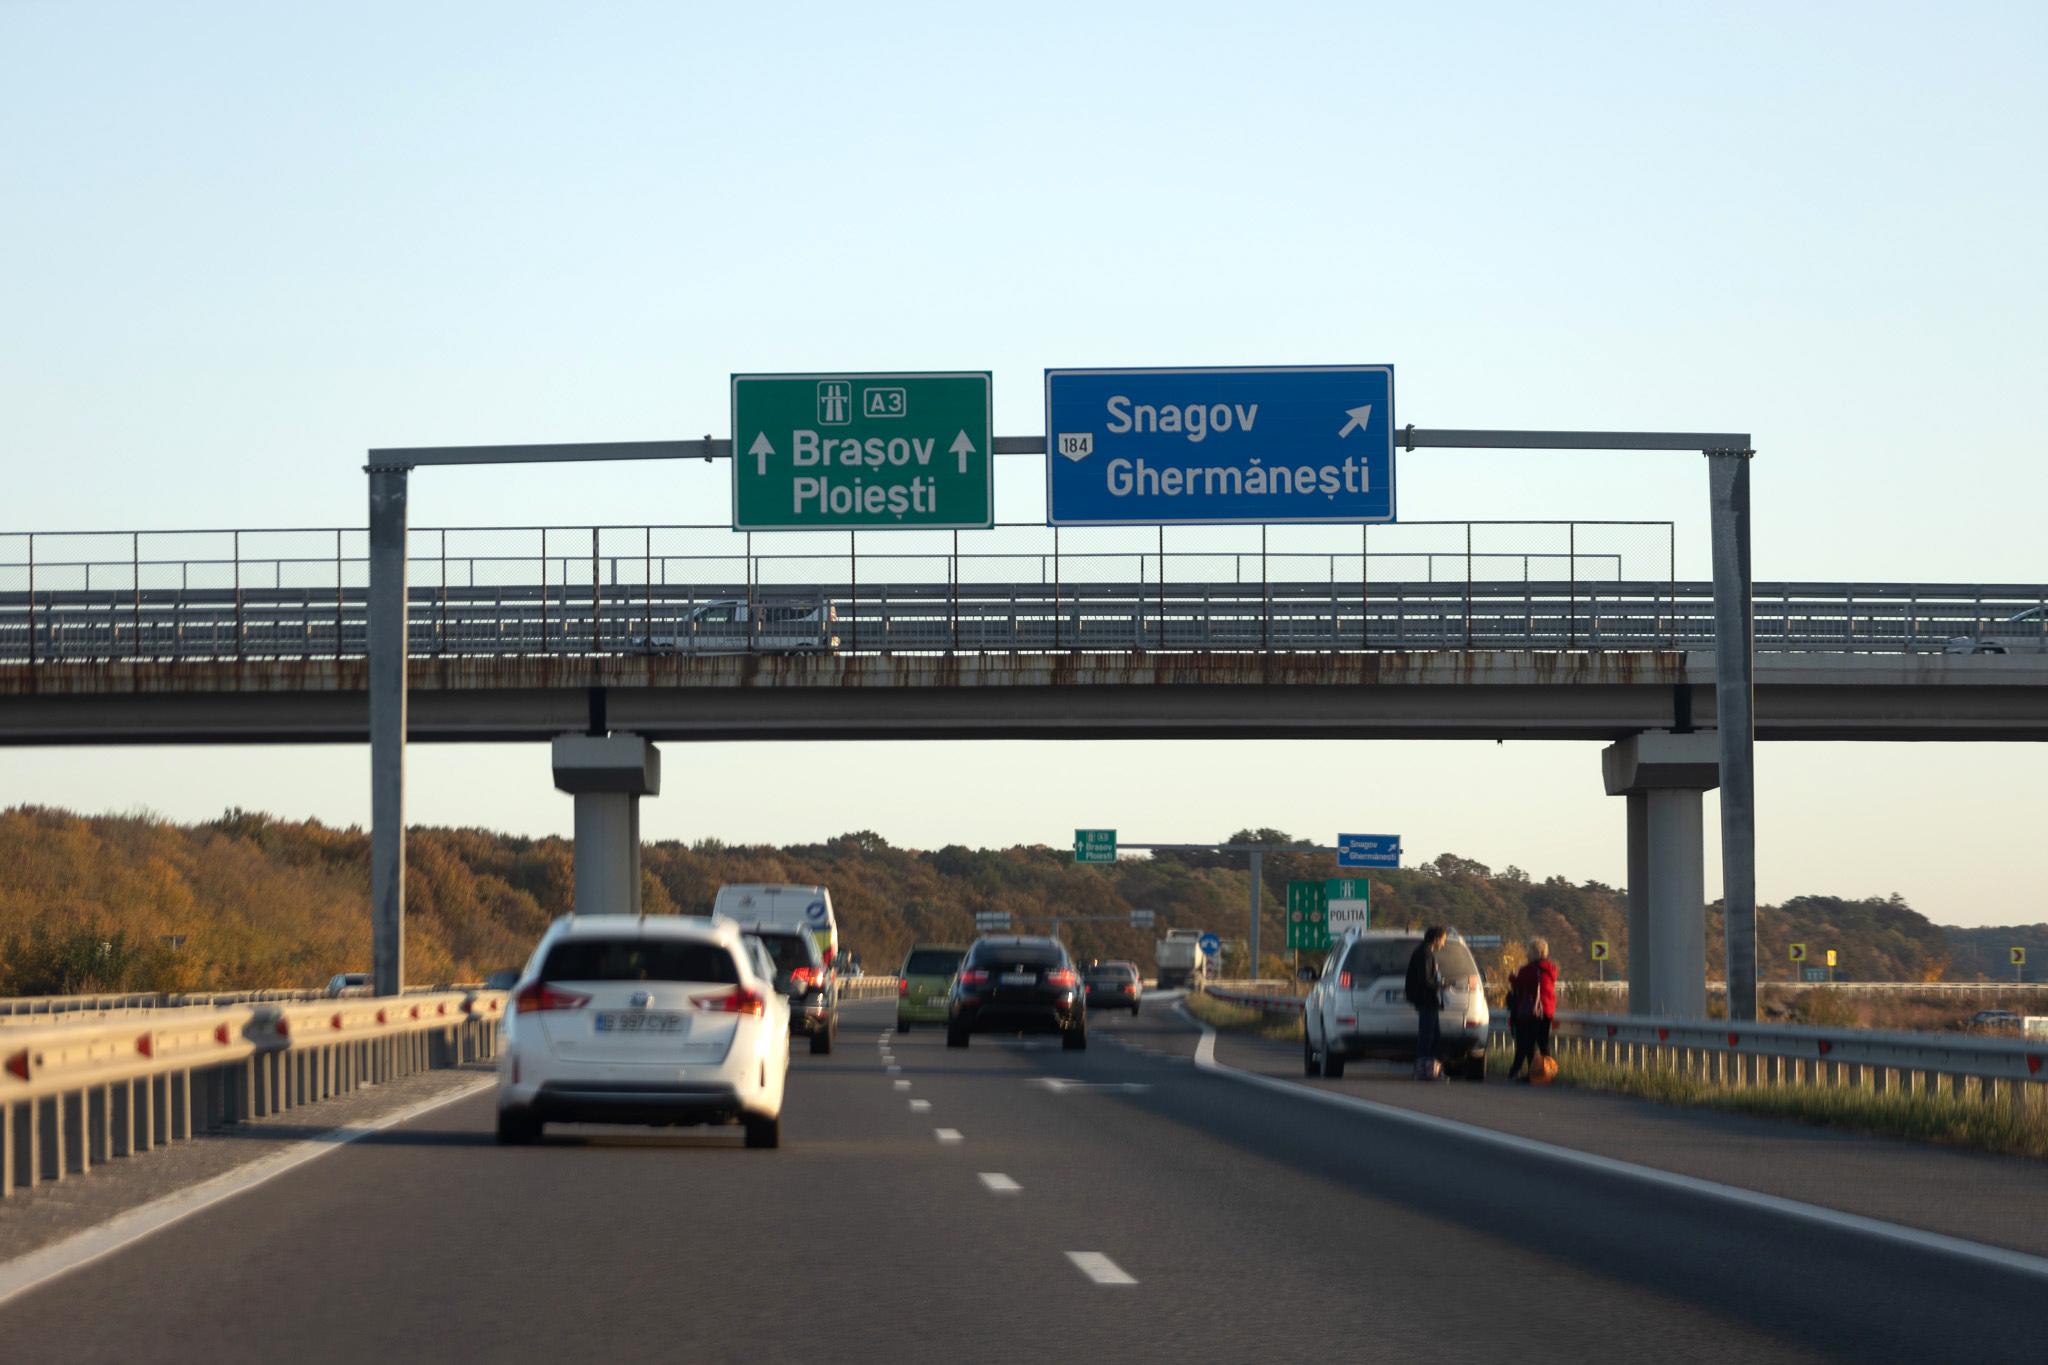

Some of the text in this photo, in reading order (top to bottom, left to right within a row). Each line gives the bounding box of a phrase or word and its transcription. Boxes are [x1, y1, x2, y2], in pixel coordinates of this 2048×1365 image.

[870, 393, 902, 412] A3
[1106, 395, 1258, 443] Snagov
[792, 429, 935, 472] Brașov
[1063, 438, 1088, 454] 184
[793, 476, 936, 520] Ploiești
[1106, 456, 1369, 501] Ghermănești
